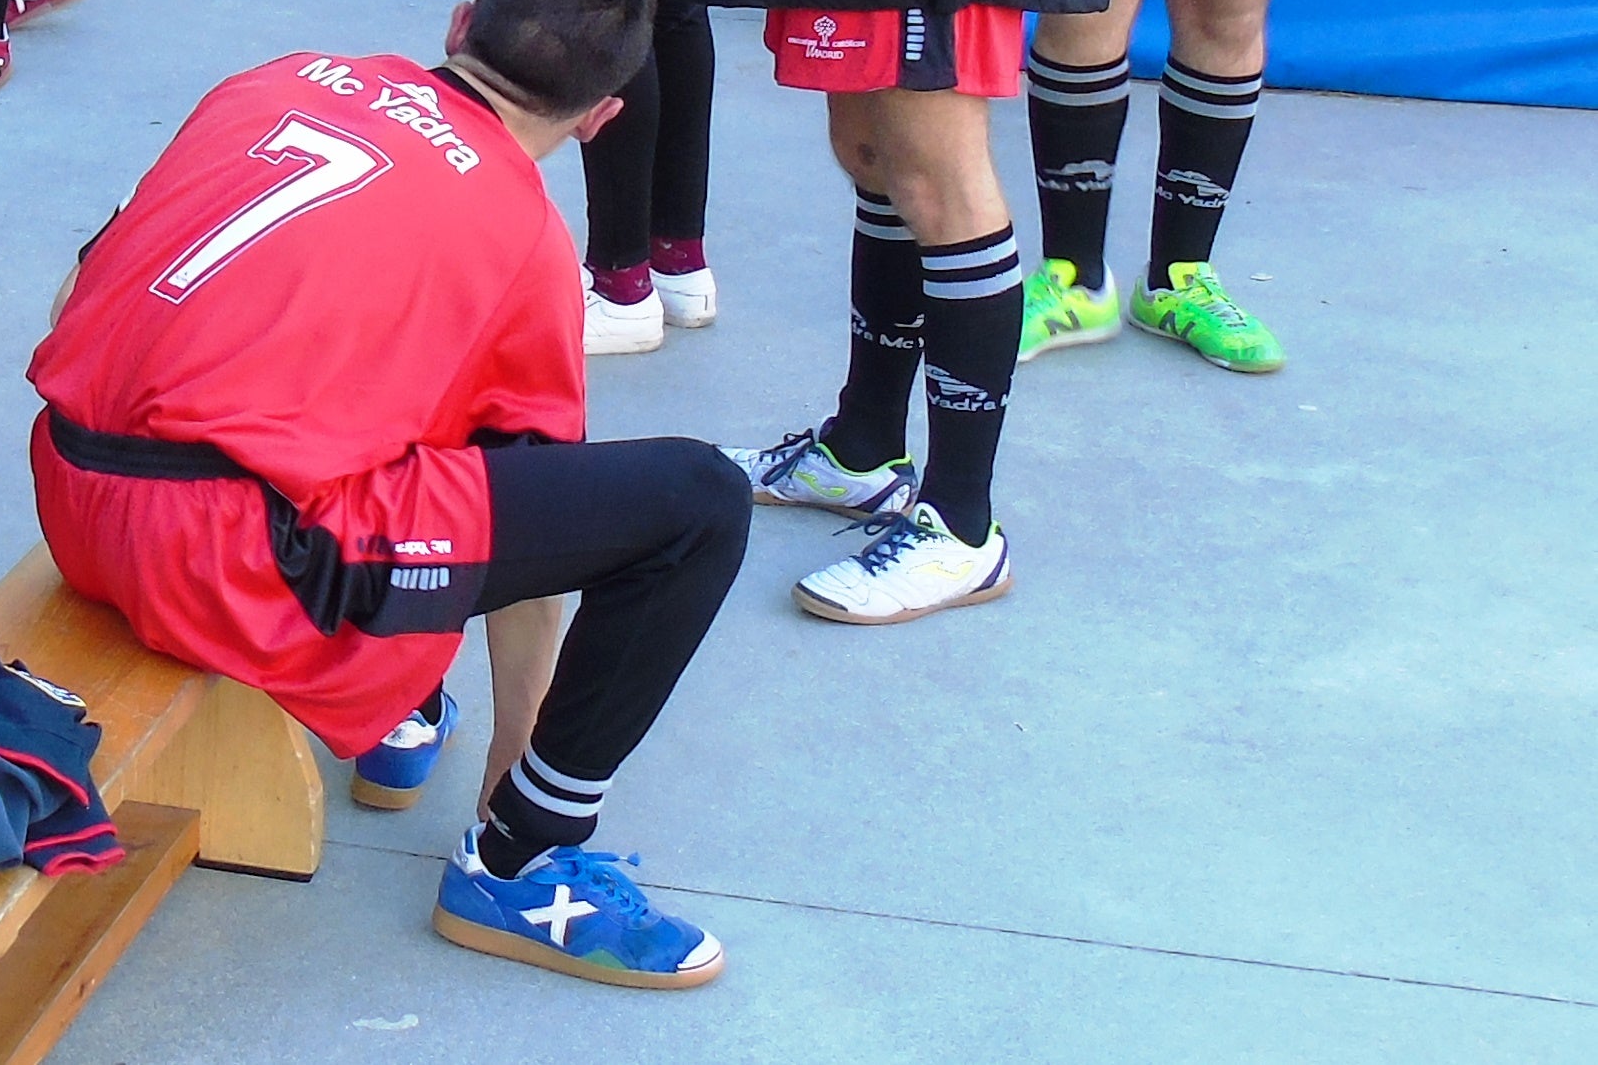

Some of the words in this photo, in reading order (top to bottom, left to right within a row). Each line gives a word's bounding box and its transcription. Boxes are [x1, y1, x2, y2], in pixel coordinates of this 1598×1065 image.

[295, 56, 365, 96] Mc
[367, 86, 482, 176] Yadra
[148, 109, 394, 305] 7
